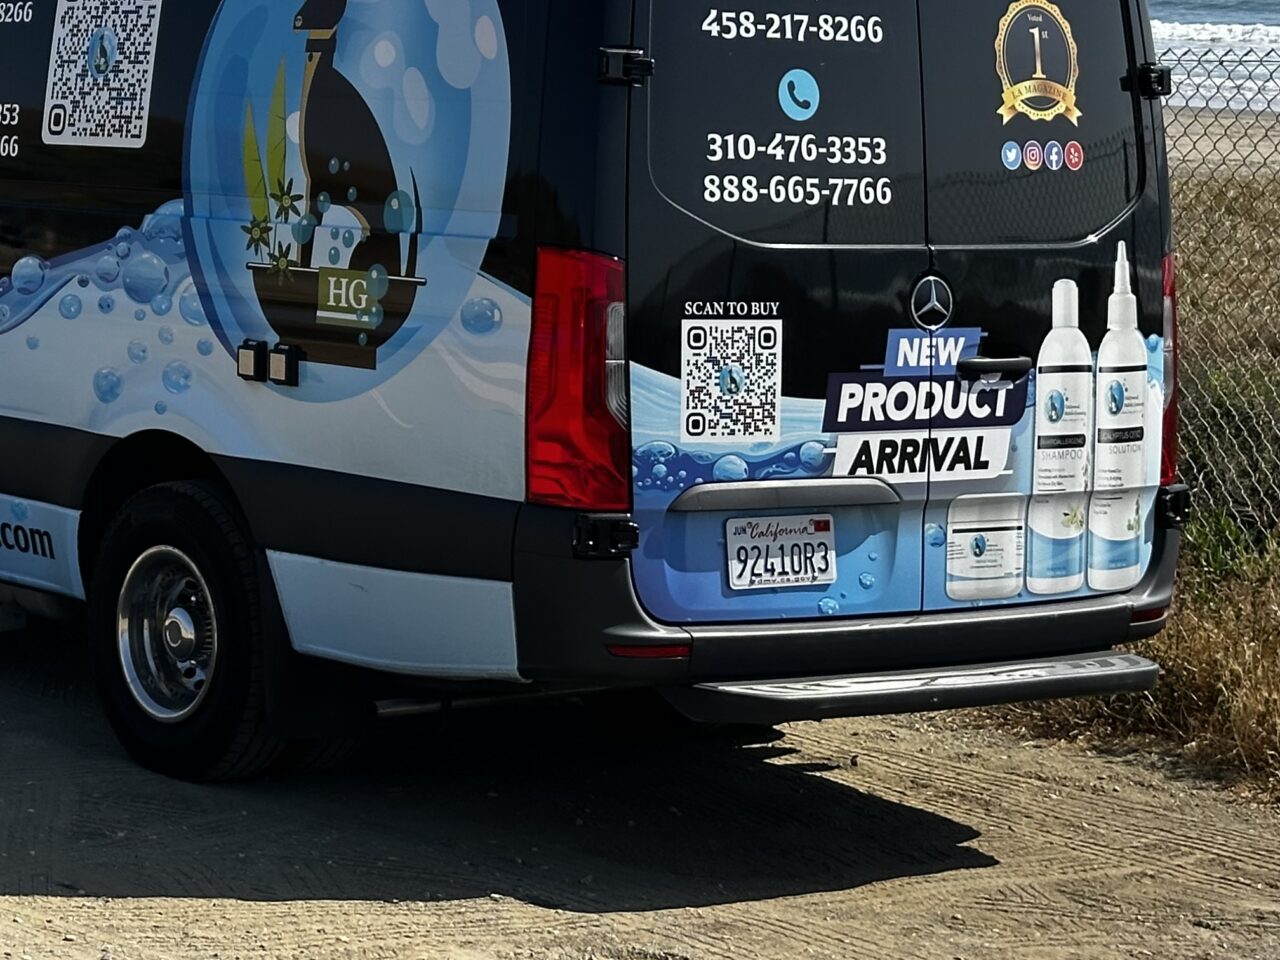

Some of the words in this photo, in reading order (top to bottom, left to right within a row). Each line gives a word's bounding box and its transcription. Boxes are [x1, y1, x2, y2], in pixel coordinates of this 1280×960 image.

[701, 8, 884, 44] 458-217-8266
[1024, 83, 1067, 101] MAGAZINE
[706, 133, 887, 166] 310-476-3353
[702, 175, 892, 206] 888-665-7766
[327, 276, 369, 309] HG
[684, 301, 724, 316] SCAN
[726, 301, 748, 316] TO
[751, 301, 780, 315] BUY
[896, 336, 966, 367] NEW
[836, 380, 1015, 424] PRODUCT
[847, 436, 990, 476] ARRIVAL
[1041, 449, 1083, 461] SHAMPOO
[1108, 444, 1142, 455] SOLUTION
[733, 526, 747, 536] JUN
[747, 520, 815, 542] California
[736, 542, 828, 579] 92410R3
[757, 575, 811, 585] dmv.ca.gov
